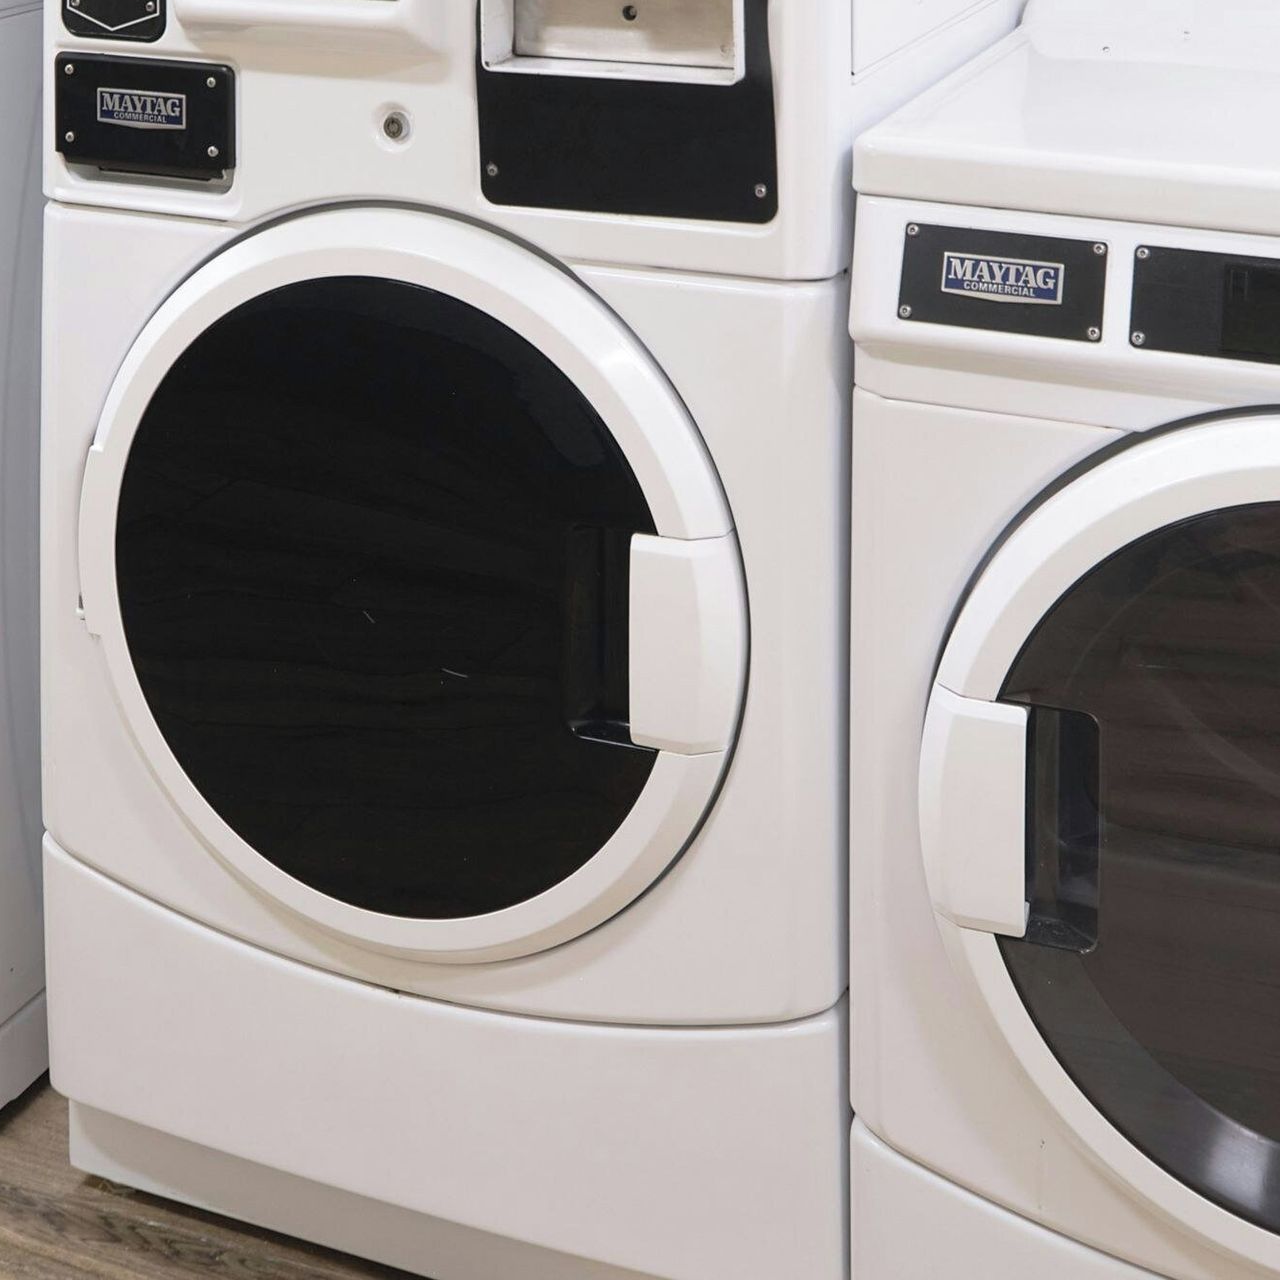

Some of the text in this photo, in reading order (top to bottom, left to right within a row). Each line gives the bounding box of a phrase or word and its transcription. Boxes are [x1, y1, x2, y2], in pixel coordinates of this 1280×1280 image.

[101, 93, 180, 117] MAYTAG
[113, 111, 167, 123] COMMERCIAL
[948, 257, 1056, 290] MAYTAG
[963, 280, 1036, 297] COMMERCIAL
